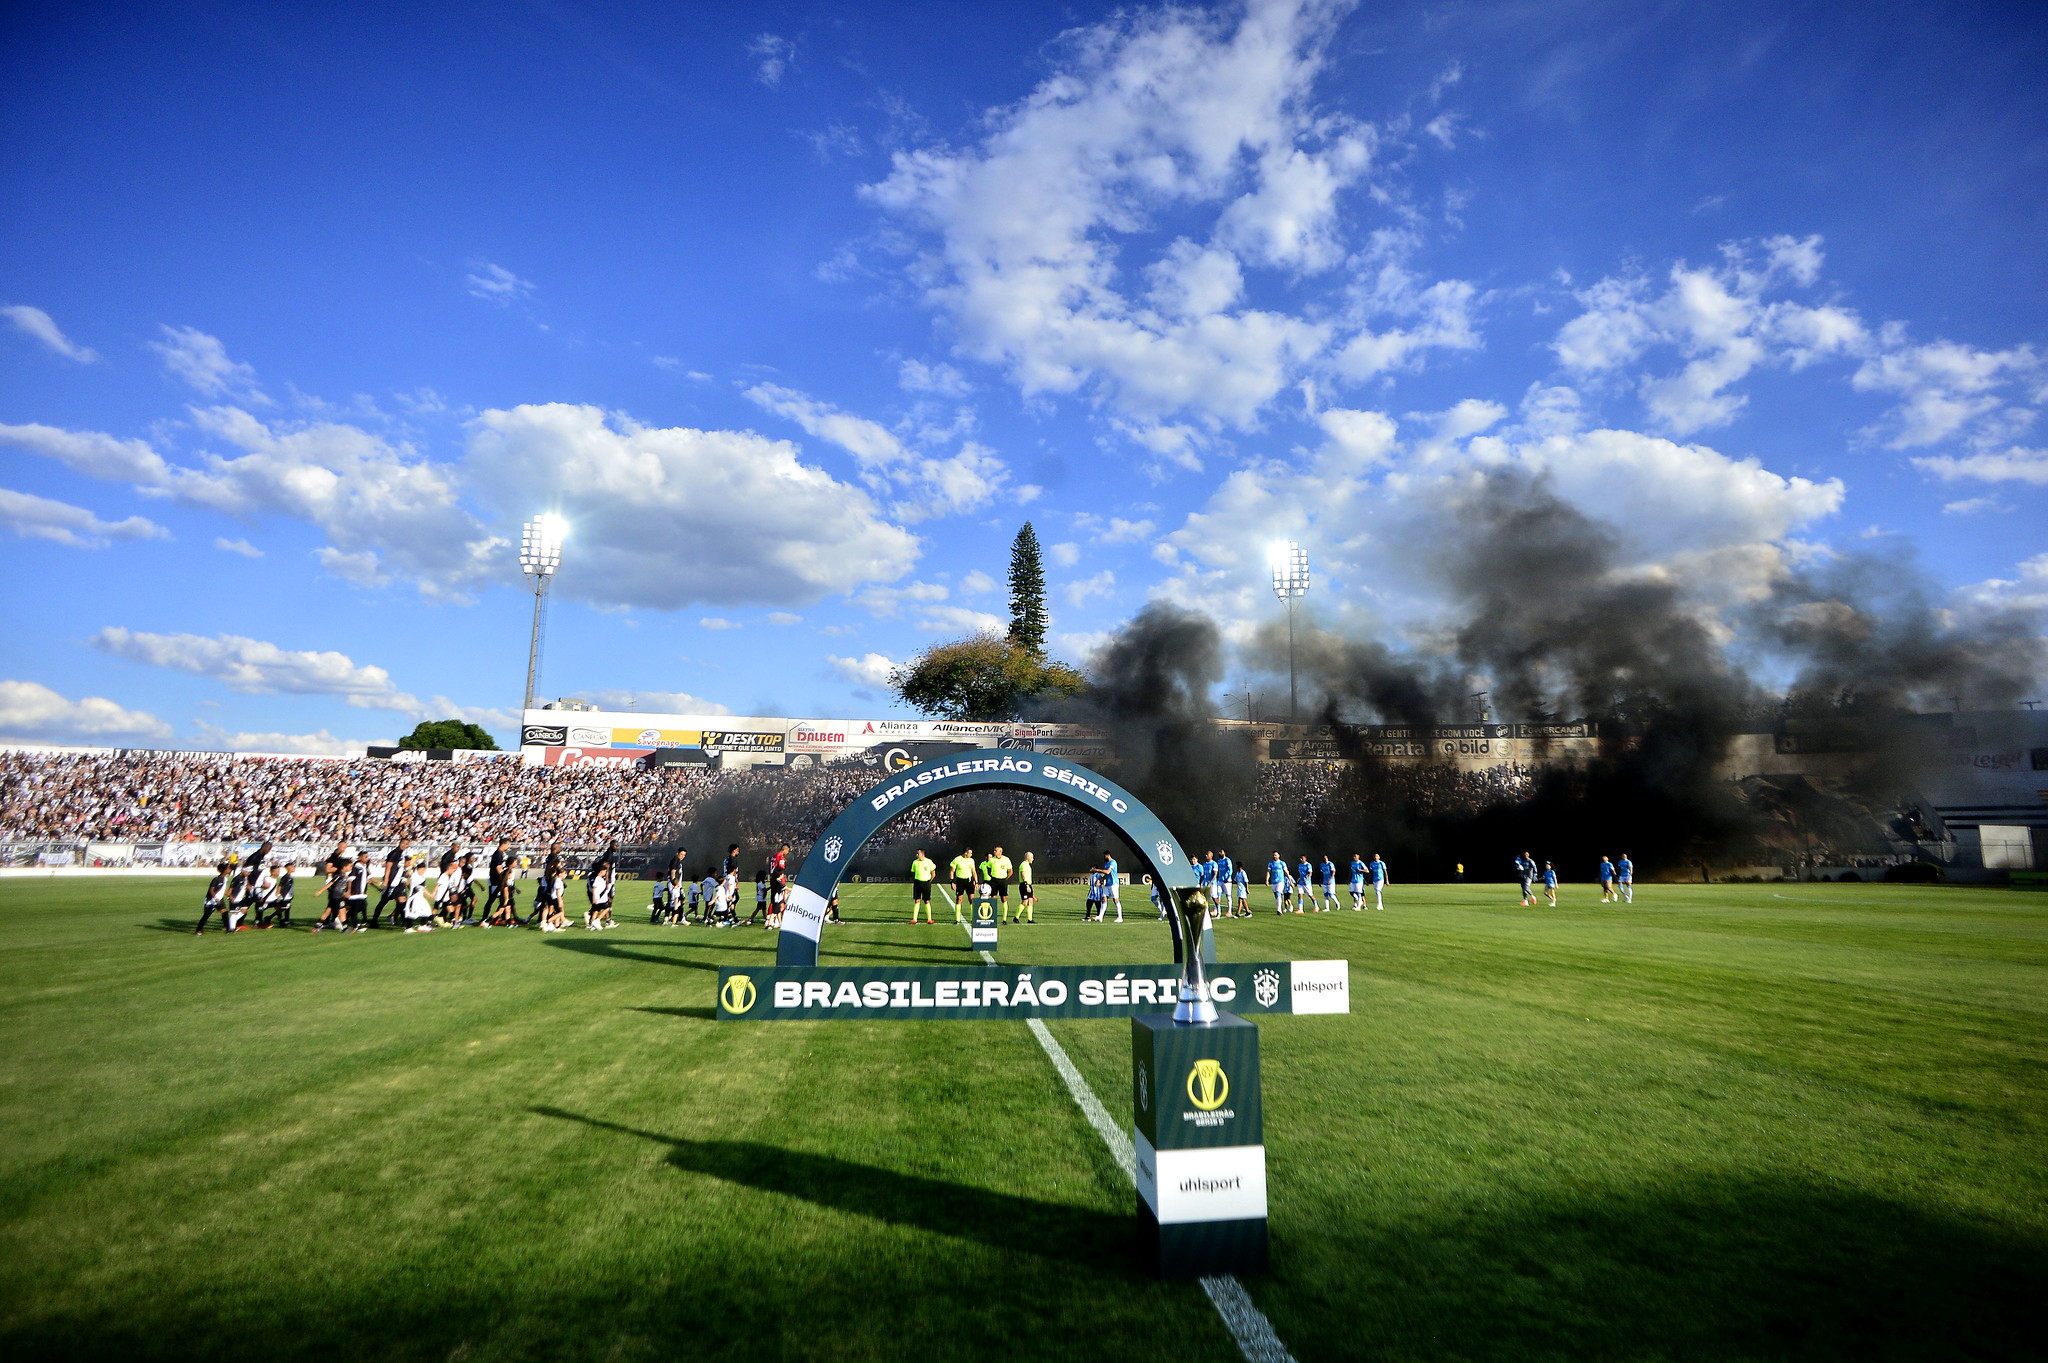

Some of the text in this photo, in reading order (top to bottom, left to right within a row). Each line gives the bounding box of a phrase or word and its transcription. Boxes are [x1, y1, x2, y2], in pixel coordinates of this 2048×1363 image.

[879, 722, 918, 730] Alianza
[525, 730, 564, 740] CANECÃO
[797, 732, 845, 742] DALBEM
[1015, 729, 1054, 737] SigmaPort
[1442, 729, 1461, 737] COM
[1464, 727, 1485, 738] VOCÊ
[637, 739, 680, 748] Savegnago
[723, 734, 782, 745] DESKTOP
[1303, 741, 1338, 749] Aroma
[1362, 741, 1426, 756] Renata
[1459, 740, 1489, 754] bild
[871, 756, 1128, 814] BRASILEIRÃO SÉRIE C
[785, 903, 821, 922] uhlsport
[774, 973, 1236, 1008] BRASILEIRÃO SÉRI C
[1294, 981, 1343, 993] uhlsport
[1179, 1176, 1241, 1193] uhlsport
